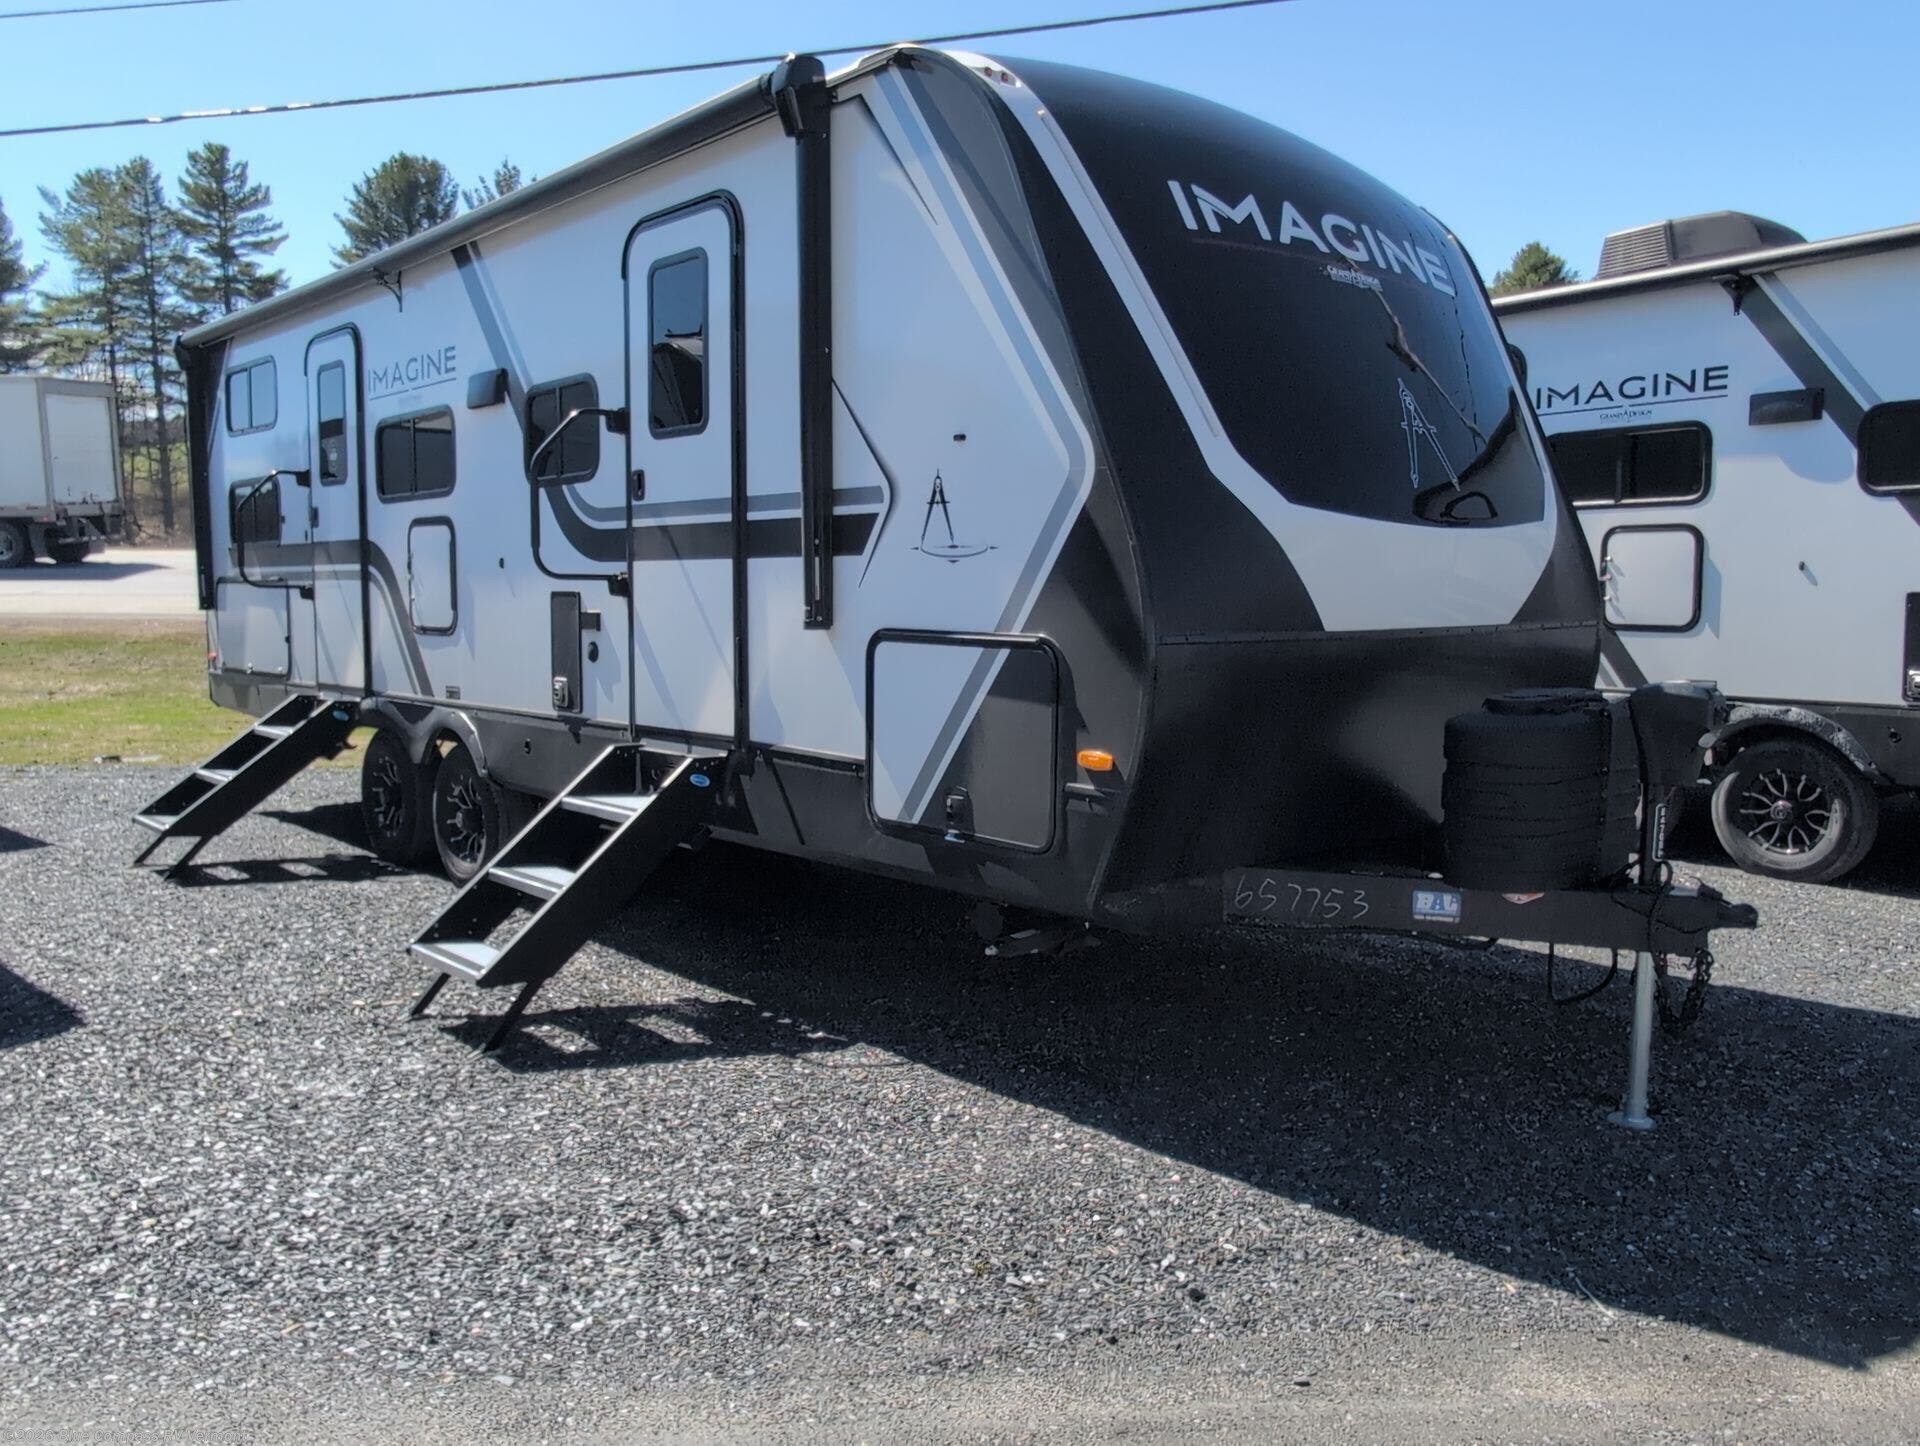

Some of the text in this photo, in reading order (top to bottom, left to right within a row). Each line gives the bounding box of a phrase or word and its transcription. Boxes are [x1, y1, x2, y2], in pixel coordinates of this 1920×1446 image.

[1166, 179, 1456, 298] IMAGINE
[367, 345, 457, 394] IMAGINE
[1535, 364, 1730, 410] IMAGINE
[1234, 874, 1369, 919] 657753
